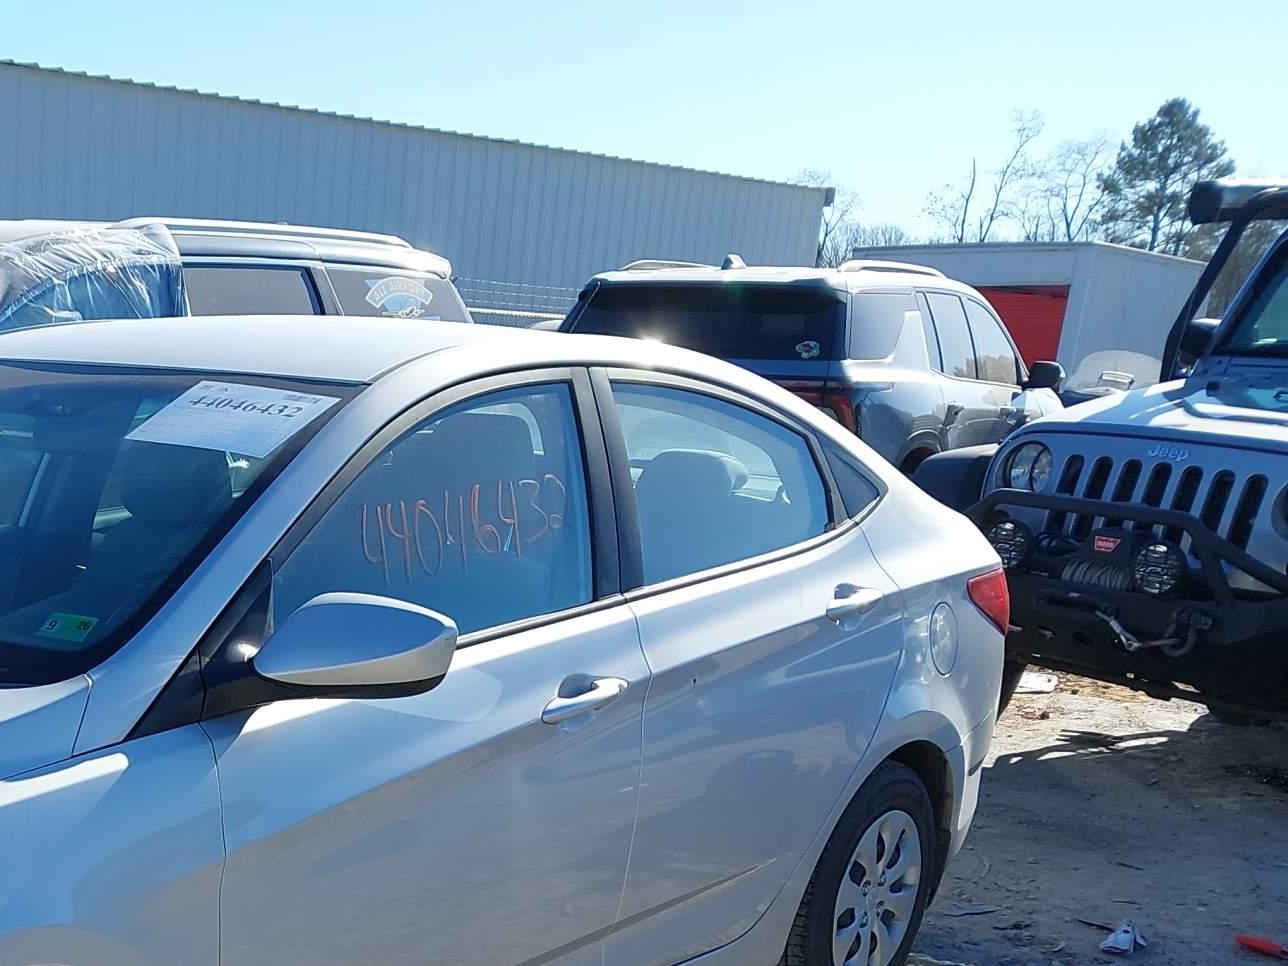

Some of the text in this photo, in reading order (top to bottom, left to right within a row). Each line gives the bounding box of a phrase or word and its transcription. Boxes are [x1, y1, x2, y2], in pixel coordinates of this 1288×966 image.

[189, 395, 303, 418] 44046432
[1147, 444, 1190, 462] Jeep
[46, 619, 58, 631] 9
